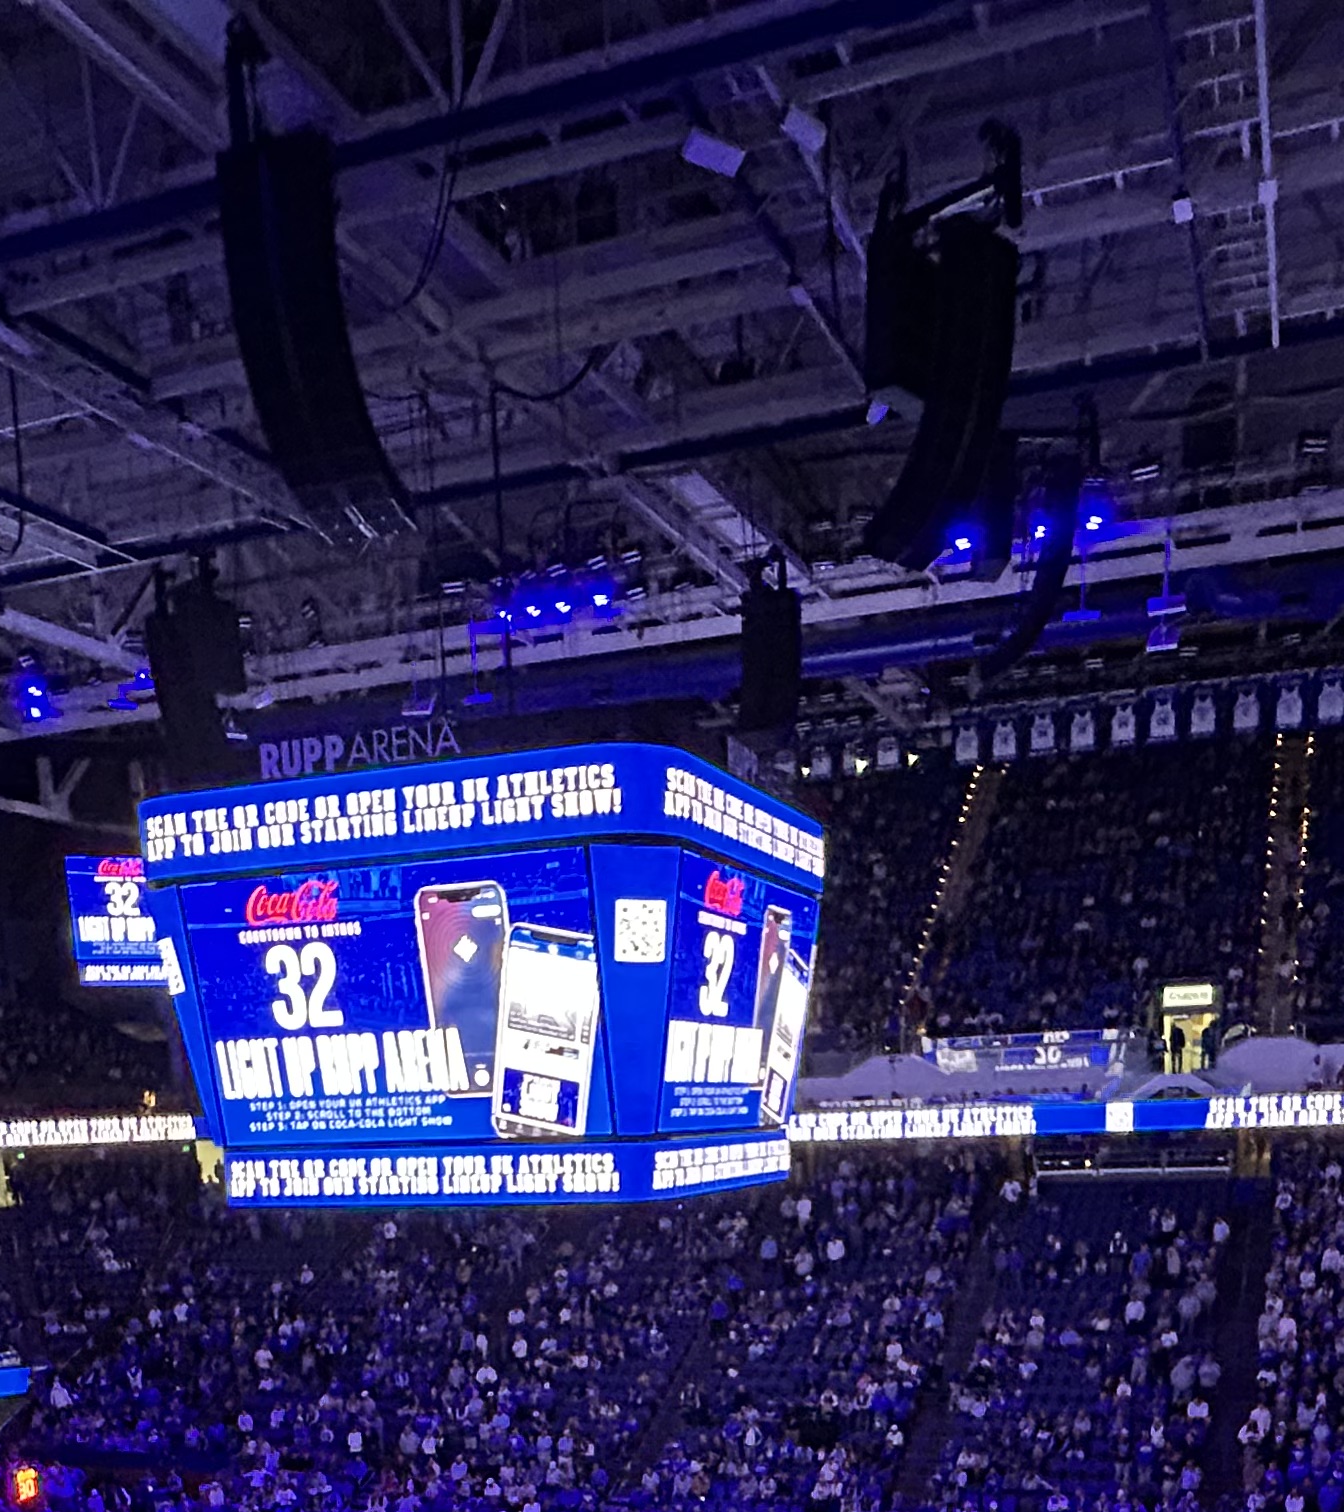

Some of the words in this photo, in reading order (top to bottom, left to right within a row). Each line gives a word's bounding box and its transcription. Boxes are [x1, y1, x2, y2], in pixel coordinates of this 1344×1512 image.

[260, 730, 346, 778] RUPP
[347, 719, 461, 768] ARENA
[146, 812, 185, 837] SCAN
[191, 807, 229, 832] THE
[232, 803, 259, 827] QR
[263, 798, 308, 824] CODE
[314, 794, 341, 818] OR
[345, 788, 396, 815] OPEN
[401, 781, 456, 809] YOUR
[461, 777, 490, 802] UK
[493, 763, 615, 799] ATHLETICS
[146, 835, 175, 860] APP
[181, 832, 203, 856] TO
[208, 827, 251, 853] JOIN
[256, 822, 294, 848] OUR
[299, 811, 397, 844] STARTING
[401, 803, 474, 833] LINEUP
[480, 795, 545, 825] LIGHT
[550, 787, 623, 818] SHOW!
[105, 882, 141, 916] 32
[303, 925, 318, 939] TO
[264, 941, 344, 1029] 32
[700, 932, 731, 1016] 32
[215, 1037, 284, 1099] LIGHT
[281, 1036, 317, 1096] UP
[315, 1032, 381, 1095] RUPP
[378, 1027, 469, 1093] ARENA
[250, 1101, 274, 1111] STEP
[289, 1099, 315, 1109] OPEN
[319, 1098, 344, 1108] YOUR
[348, 1098, 361, 1107] UK
[365, 1095, 421, 1107] ATHLETICS
[423, 1094, 447, 1104] APP
[250, 1121, 274, 1131] STEP
[290, 1120, 308, 1130] TAP
[311, 1120, 325, 1130] ON
[328, 1118, 384, 1129] COCA-COLA
[387, 1117, 417, 1128] LIGHT
[421, 1116, 452, 1127] SHOW
[266, 1111, 290, 1121] STEP
[307, 1109, 344, 1119] SCROLL
[348, 1108, 361, 1118] TO
[365, 1107, 384, 1117] THE
[387, 1106, 431, 1117] BOTTOM
